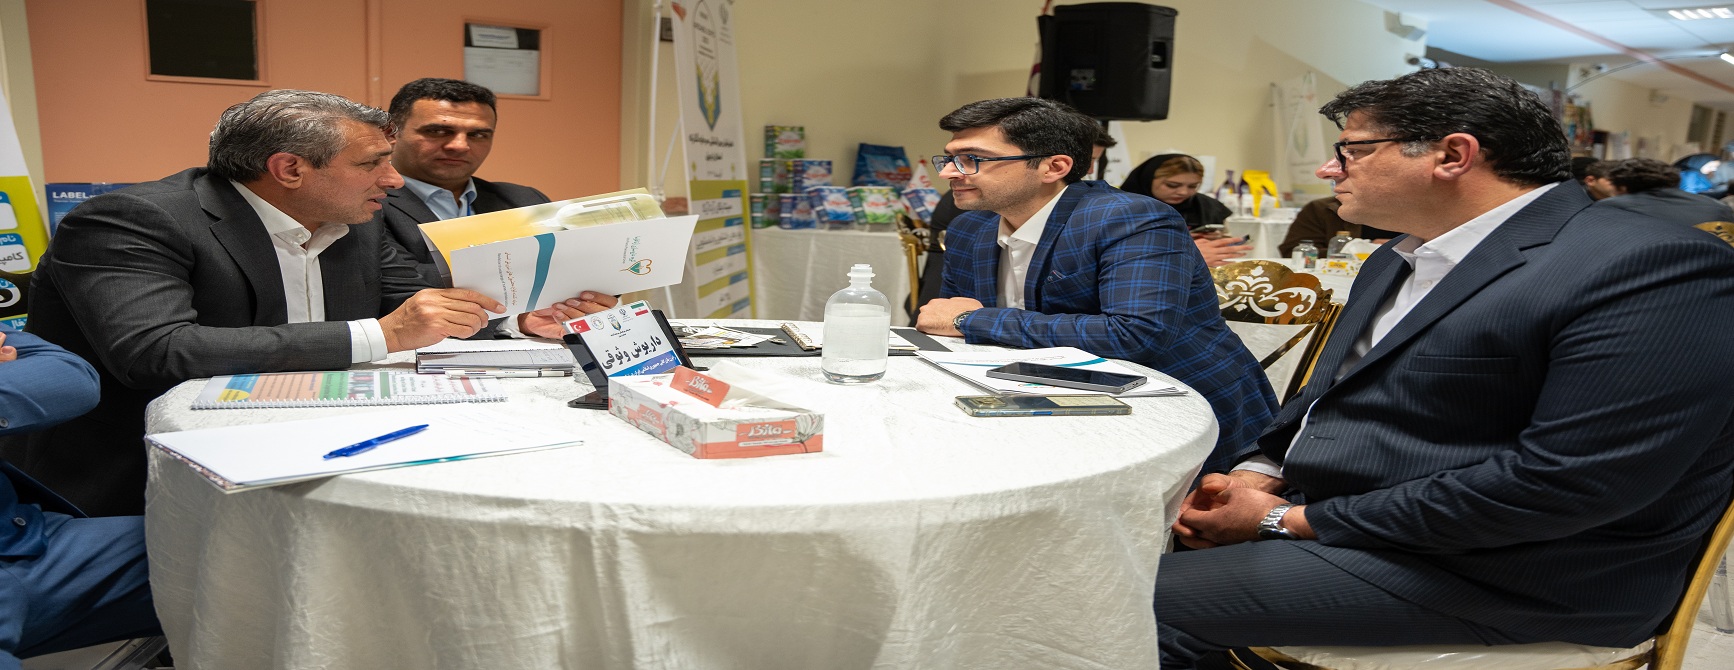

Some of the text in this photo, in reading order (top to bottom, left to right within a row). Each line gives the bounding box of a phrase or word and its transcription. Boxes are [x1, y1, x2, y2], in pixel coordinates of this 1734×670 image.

[52, 191, 89, 199] LABEL
[601, 335, 662, 369] داریوش وثوقی
